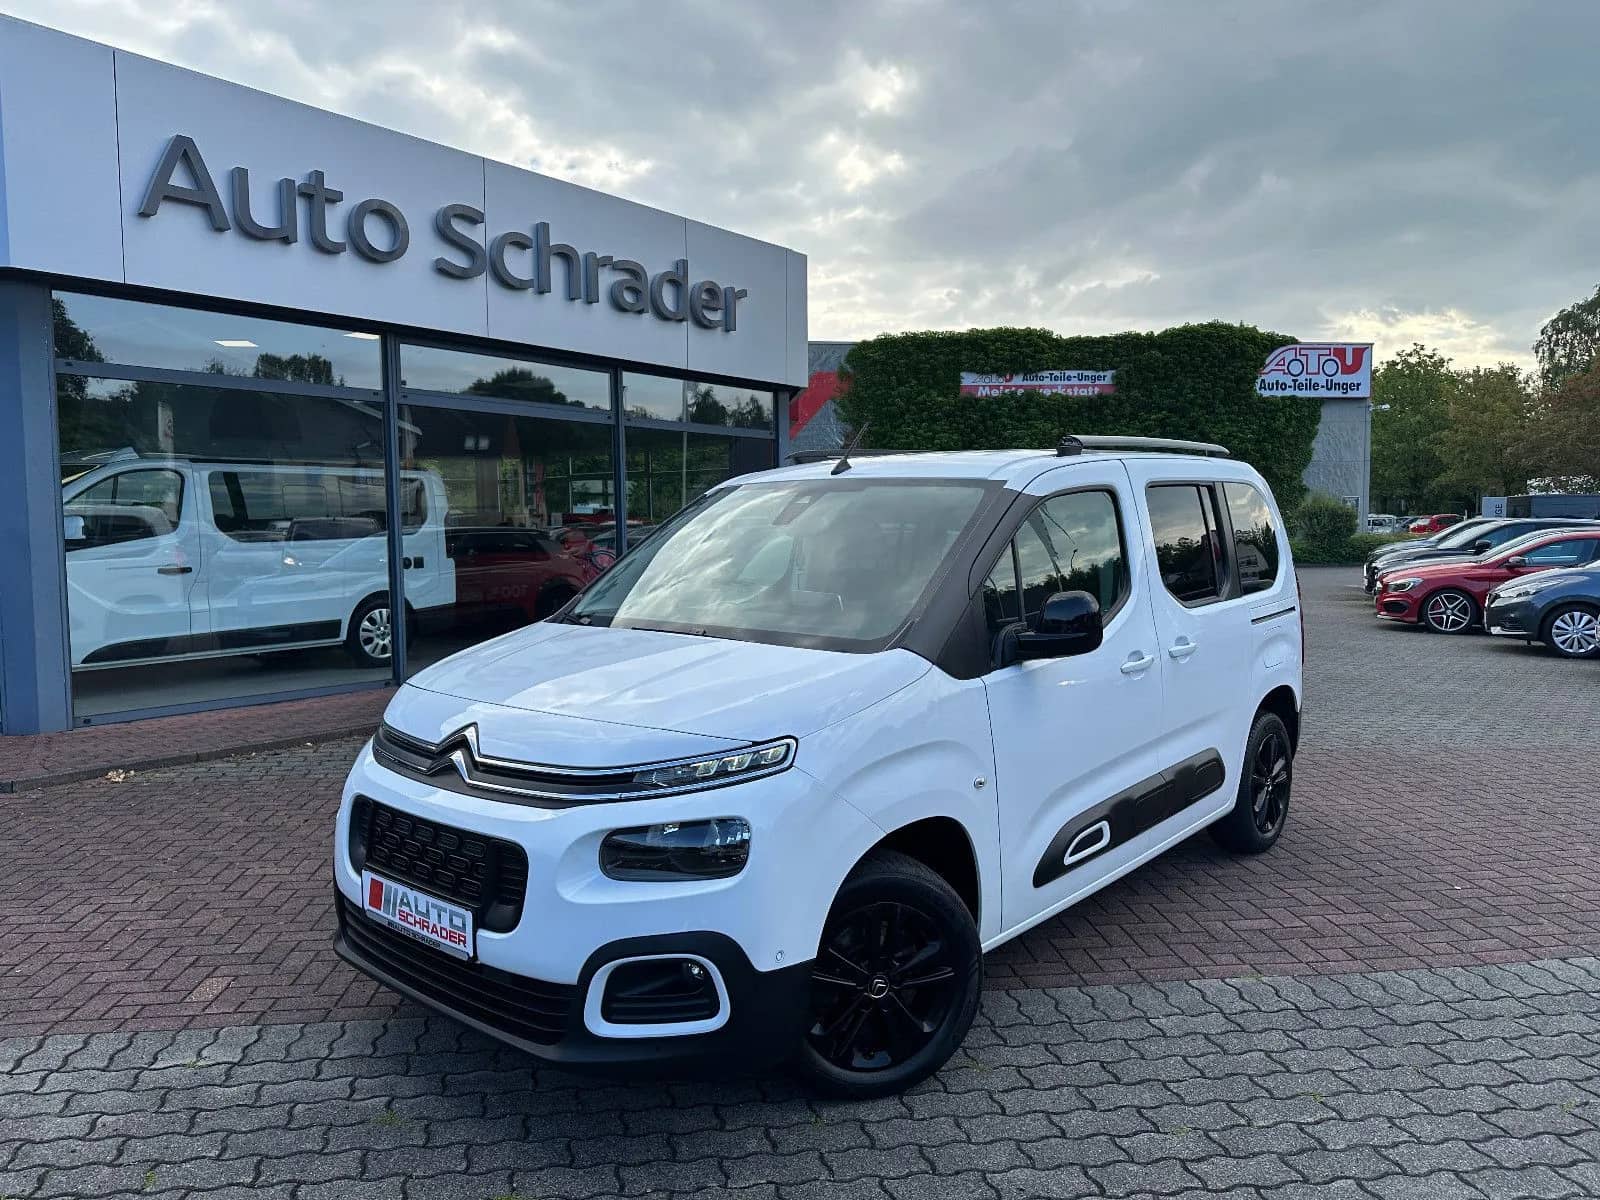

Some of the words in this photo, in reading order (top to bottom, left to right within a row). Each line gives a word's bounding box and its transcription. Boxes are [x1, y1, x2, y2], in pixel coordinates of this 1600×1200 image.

[138, 133, 410, 263] Auto
[434, 203, 748, 332] Schrader
[1022, 372, 1108, 384] Auto-Teile-Unger
[1259, 378, 1362, 394] Auto-Teile-Unger
[398, 891, 467, 933] AUTO
[398, 908, 467, 948] SCHRADER
